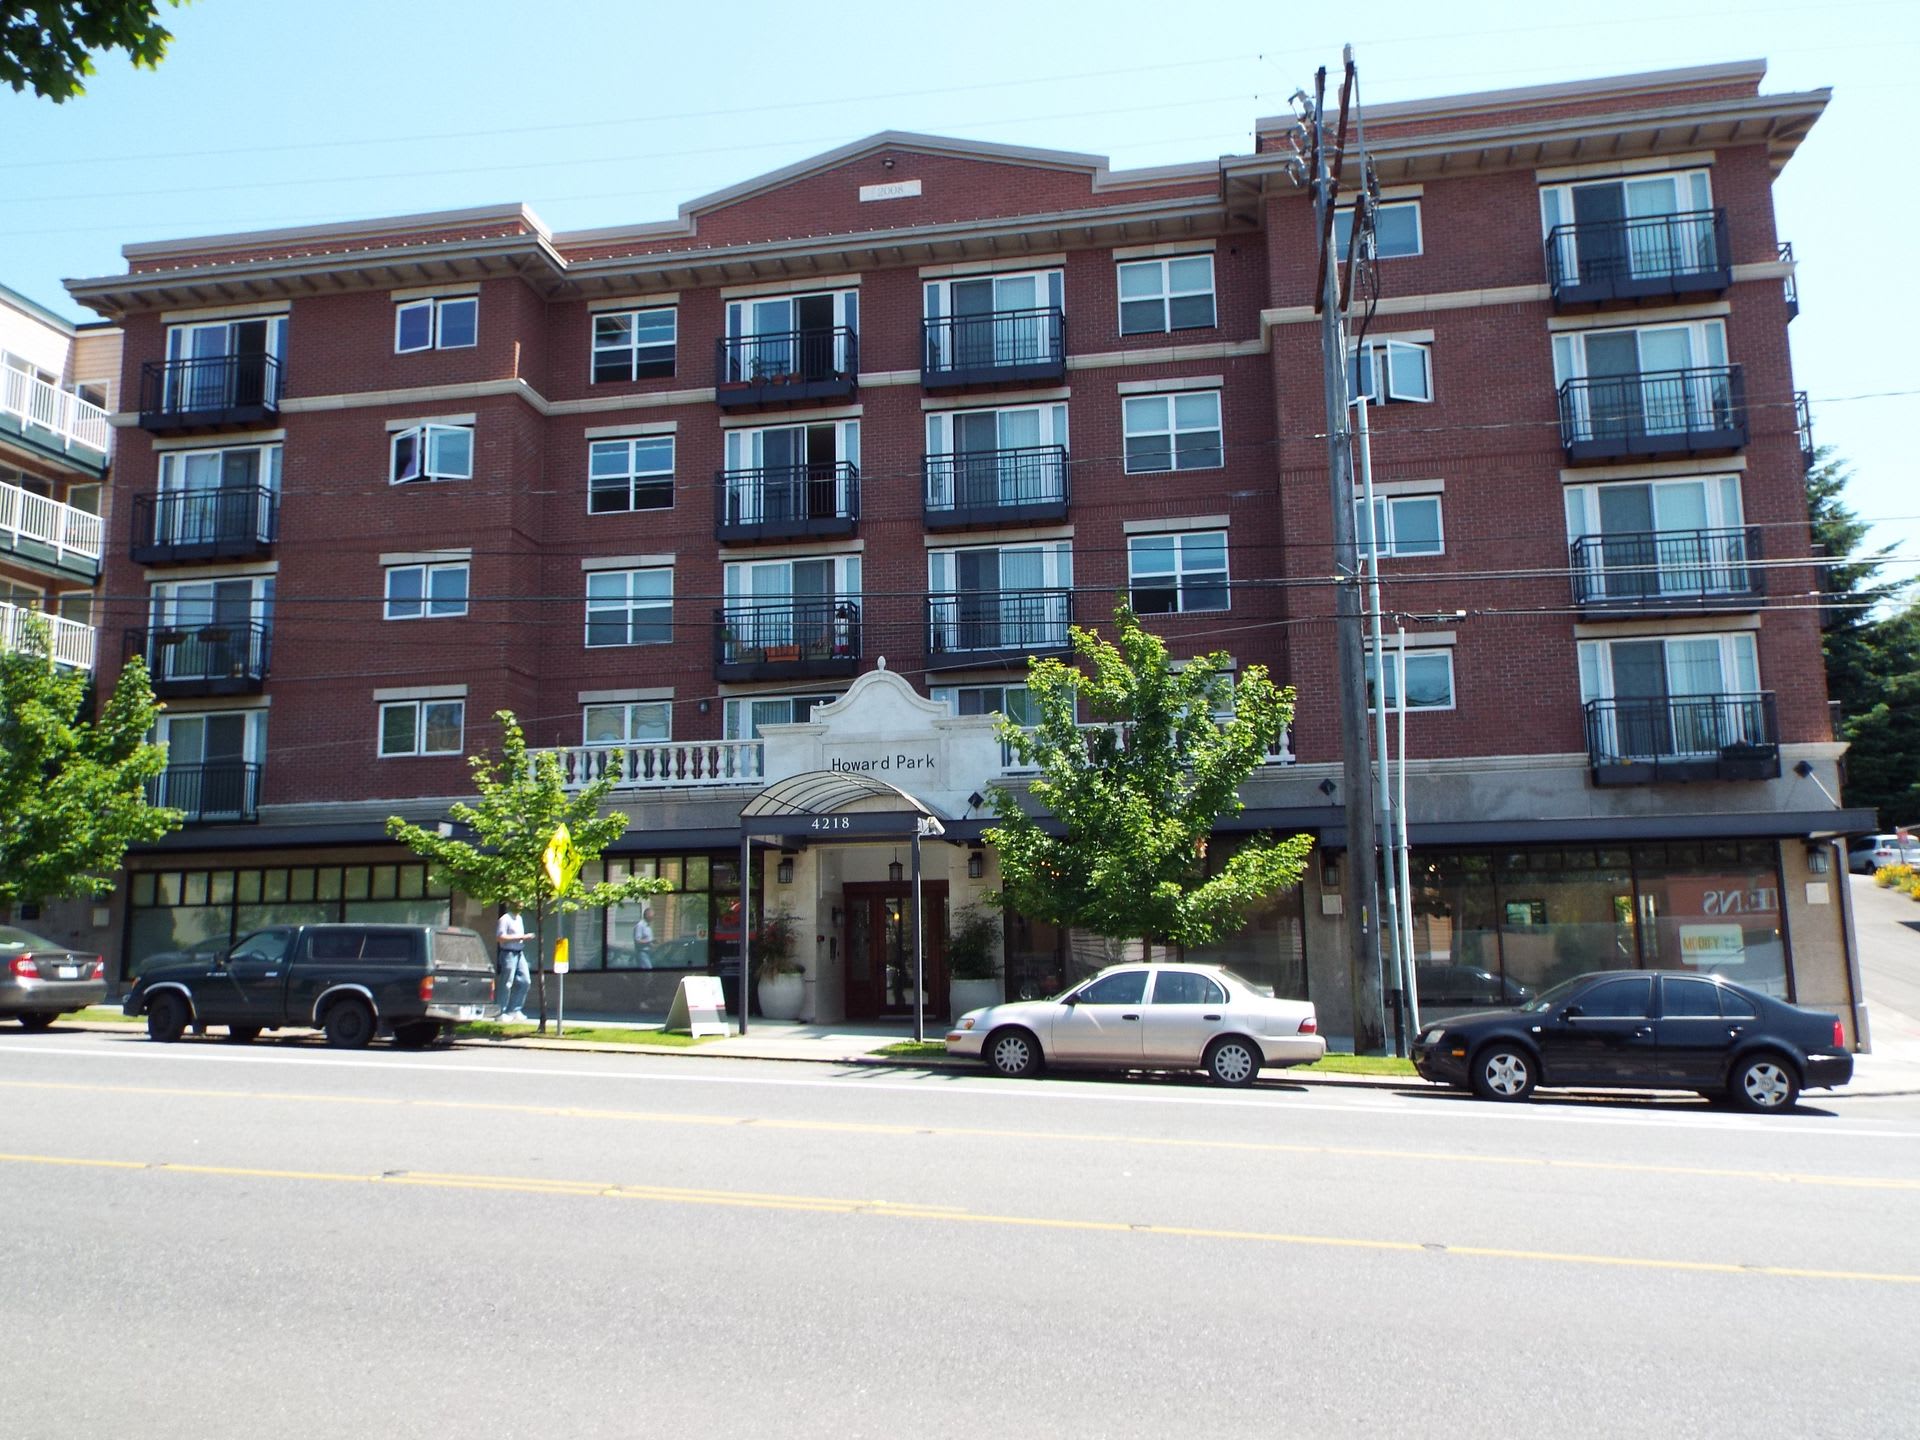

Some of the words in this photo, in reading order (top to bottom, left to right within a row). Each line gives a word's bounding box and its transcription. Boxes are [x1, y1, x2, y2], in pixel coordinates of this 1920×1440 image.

[877, 184, 904, 197] 2008
[832, 755, 890, 772] Howard
[897, 754, 935, 769] Park
[811, 817, 850, 829] 4218
